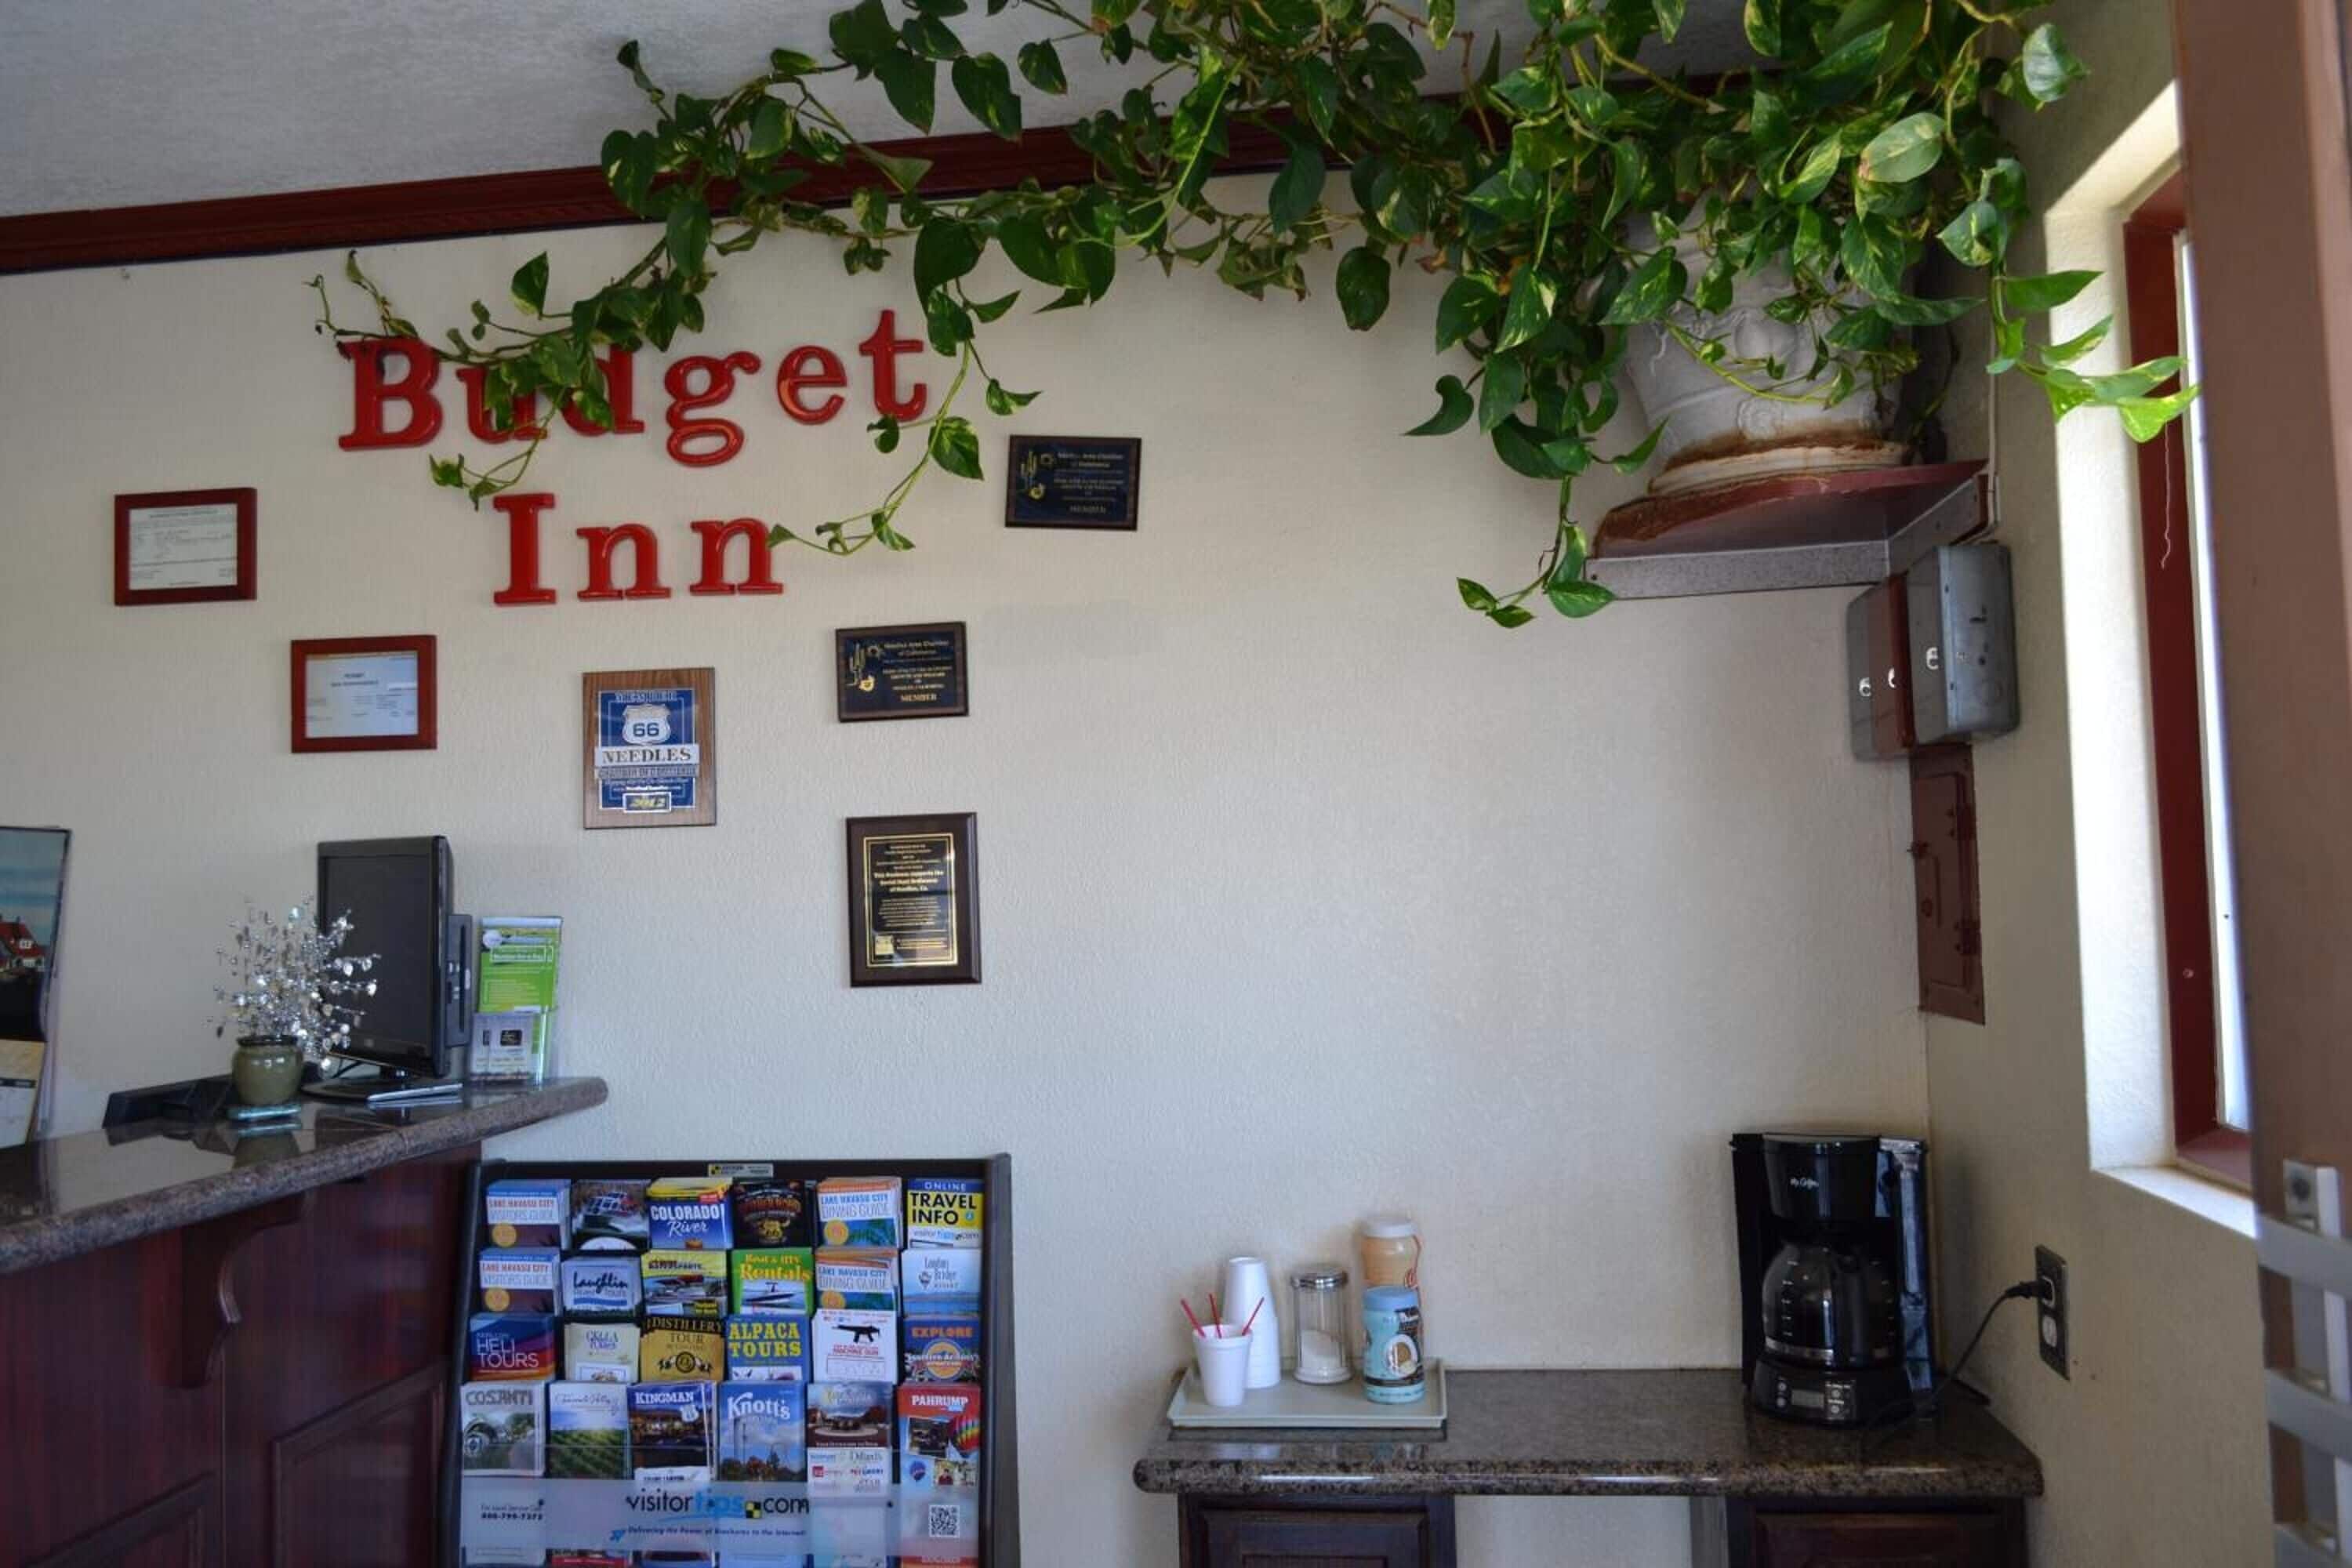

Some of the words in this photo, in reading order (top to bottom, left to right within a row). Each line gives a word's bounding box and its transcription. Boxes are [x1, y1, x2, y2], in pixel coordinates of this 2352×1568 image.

[338, 309, 927, 467] Budget
[493, 492, 784, 606] Inn
[633, 722, 659, 738] 66
[602, 748, 691, 764] NEEDLES
[924, 1181, 967, 1191] ONLINE
[822, 1196, 838, 1205] LAKE
[872, 1193, 888, 1202] CITY
[910, 1192, 978, 1210] TRAVEL
[650, 1204, 720, 1221] COLORADO
[912, 1210, 959, 1225] INFO
[667, 1220, 710, 1237] River
[482, 1263, 499, 1272] LAKE
[533, 1263, 549, 1272] CITY
[739, 1264, 811, 1281] Rentals
[818, 1267, 836, 1276] LAKE
[573, 1272, 629, 1294] Laughlin
[670, 1333, 704, 1344] TOUR
[728, 1322, 800, 1340] ALPACA
[911, 1327, 973, 1338] EXPLORE
[476, 1338, 515, 1353] HELI
[728, 1341, 801, 1358] TOURS
[479, 1352, 539, 1368] TOURS
[635, 1392, 694, 1404] KINGMAN
[727, 1392, 791, 1420] Knott's
[911, 1395, 969, 1406] PAHRUMP
